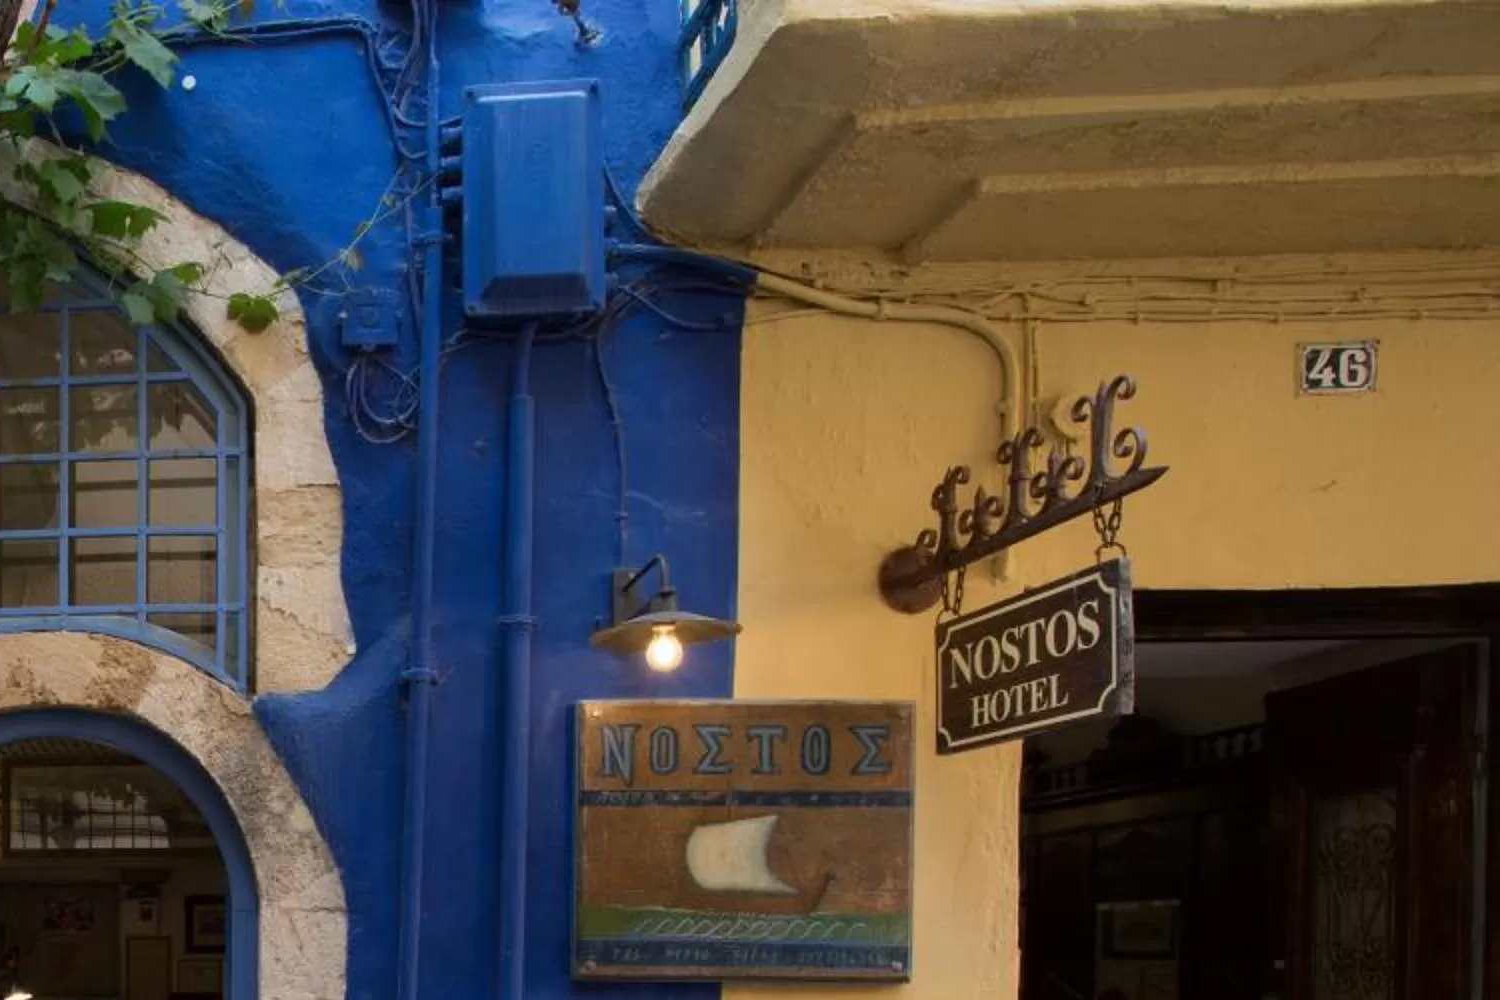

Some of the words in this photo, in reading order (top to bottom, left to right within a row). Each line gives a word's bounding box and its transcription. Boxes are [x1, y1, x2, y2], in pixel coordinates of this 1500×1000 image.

[1308, 348, 1368, 387] 46
[949, 600, 1100, 689] NOSTOS
[970, 674, 1069, 728] HOTEL
[598, 724, 892, 787] ΝΟΣΤΟΣ
